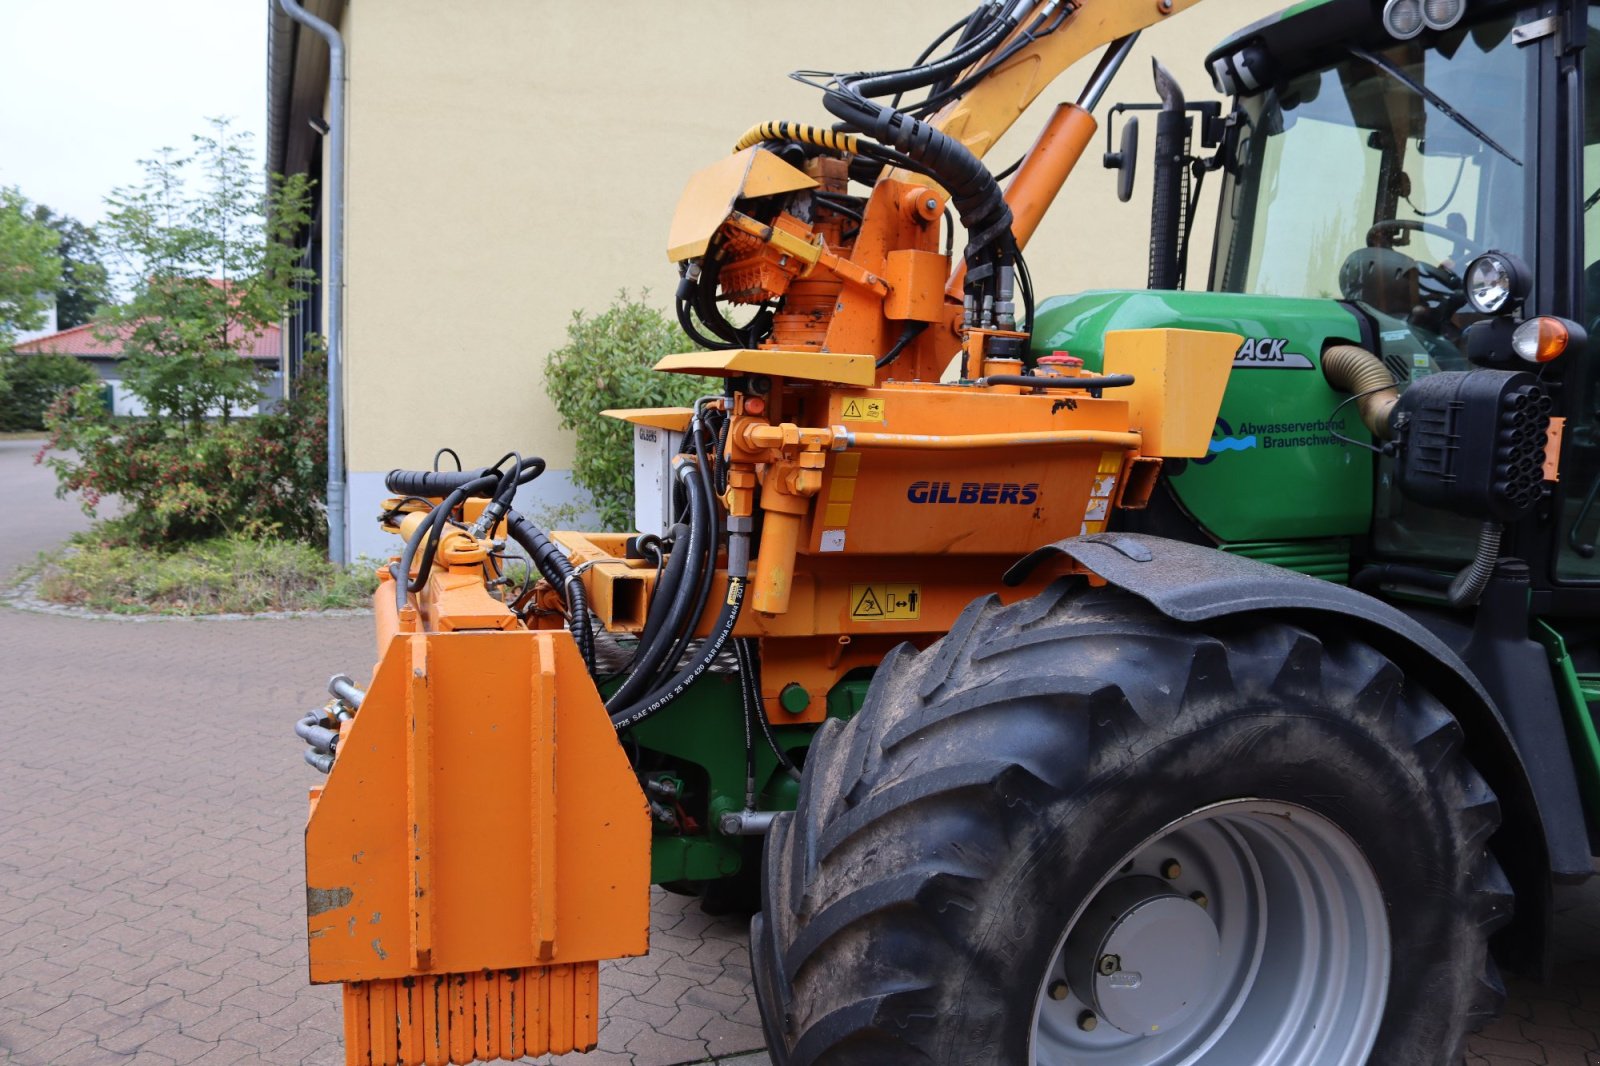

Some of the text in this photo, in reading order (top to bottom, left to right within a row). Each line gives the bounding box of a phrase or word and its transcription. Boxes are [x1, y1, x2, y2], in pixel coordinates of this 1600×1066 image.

[1234, 337, 1289, 361] ACK
[1238, 418, 1346, 435] Abwasserverband
[907, 480, 1040, 505] GILBERS
[632, 709, 648, 721] SAE
[648, 702, 660, 712] 100
[660, 692, 674, 704] R15
[674, 685, 683, 694] 25
[684, 674, 694, 686] WP
[694, 664, 705, 676] 420
[704, 649, 717, 663] BAR
[714, 629, 729, 650] MSHA
